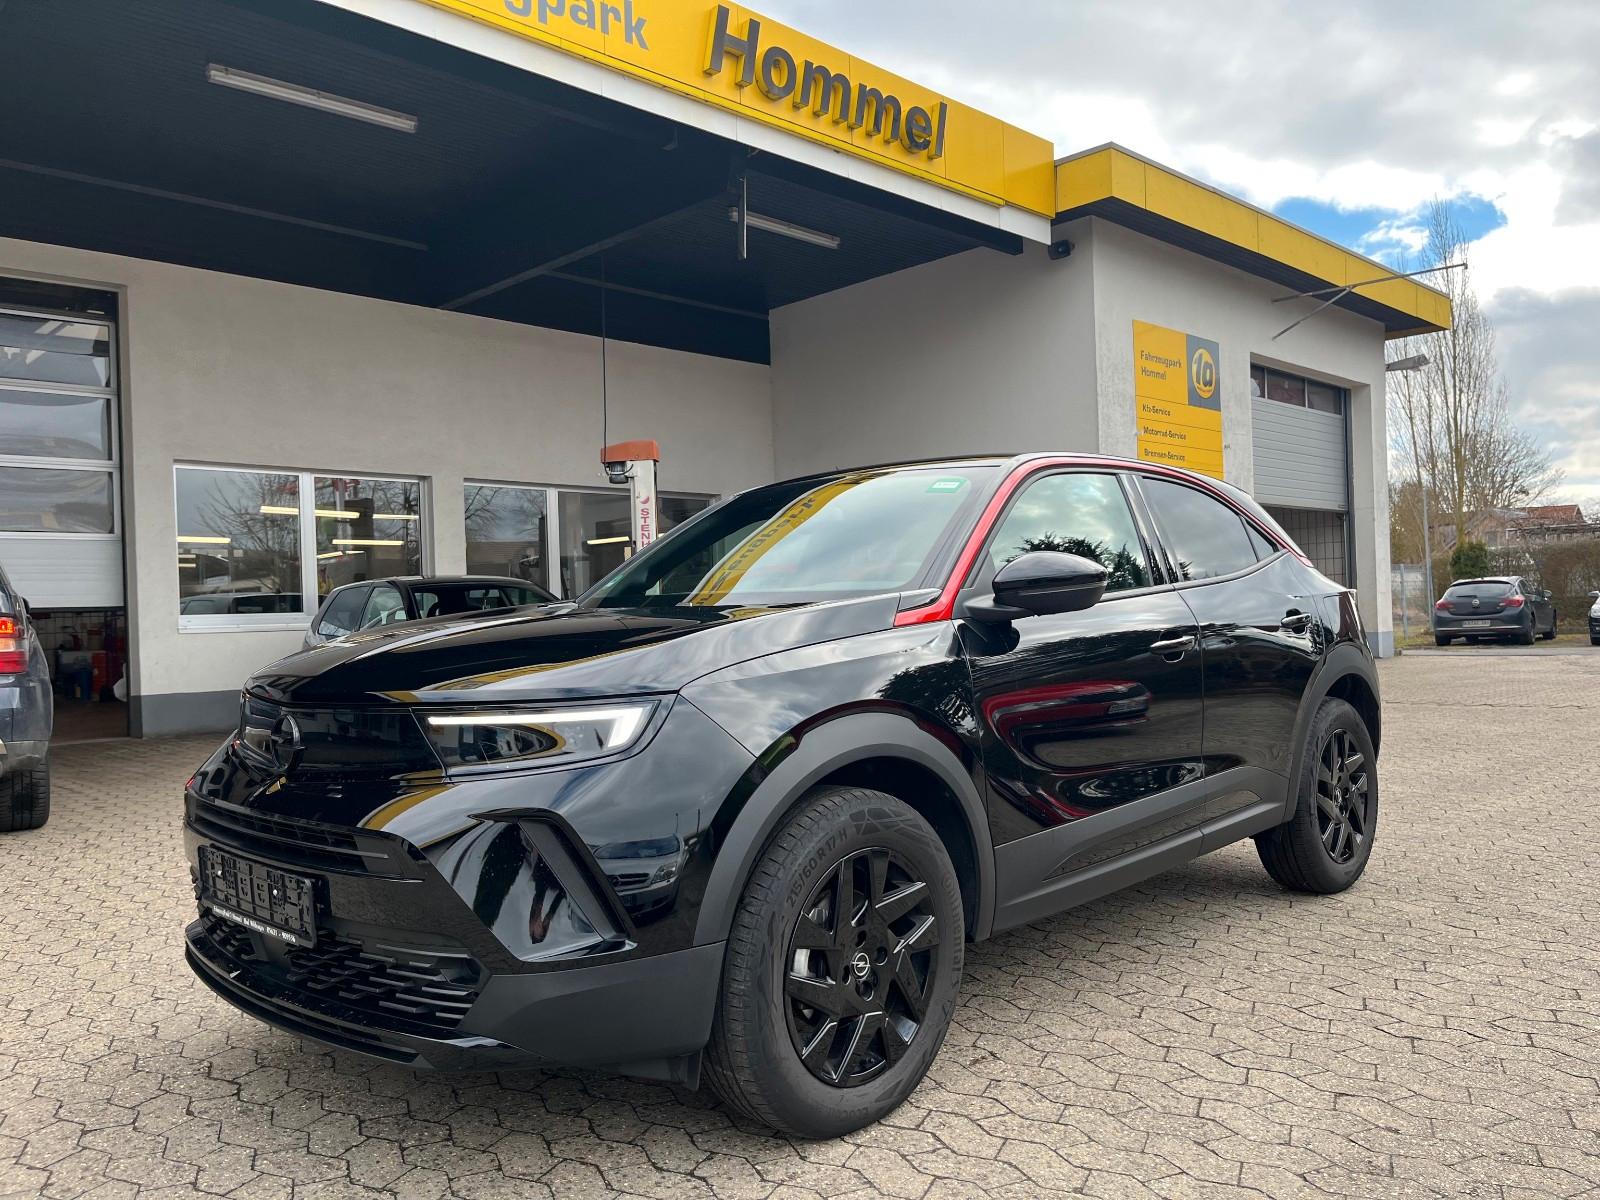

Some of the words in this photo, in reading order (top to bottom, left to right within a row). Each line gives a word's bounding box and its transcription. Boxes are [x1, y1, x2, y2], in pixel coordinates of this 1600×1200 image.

[703, 4, 948, 160] Hommel
[1140, 350, 1182, 369] Fahrzeugpark
[1141, 366, 1167, 380] Hommel
[1142, 403, 1171, 416] Kfz-Service
[1143, 426, 1187, 440] Motorrad-Service
[1144, 448, 1186, 462] Bremsen-Service
[786, 857, 818, 909] 215/60
[825, 834, 836, 852] 17
